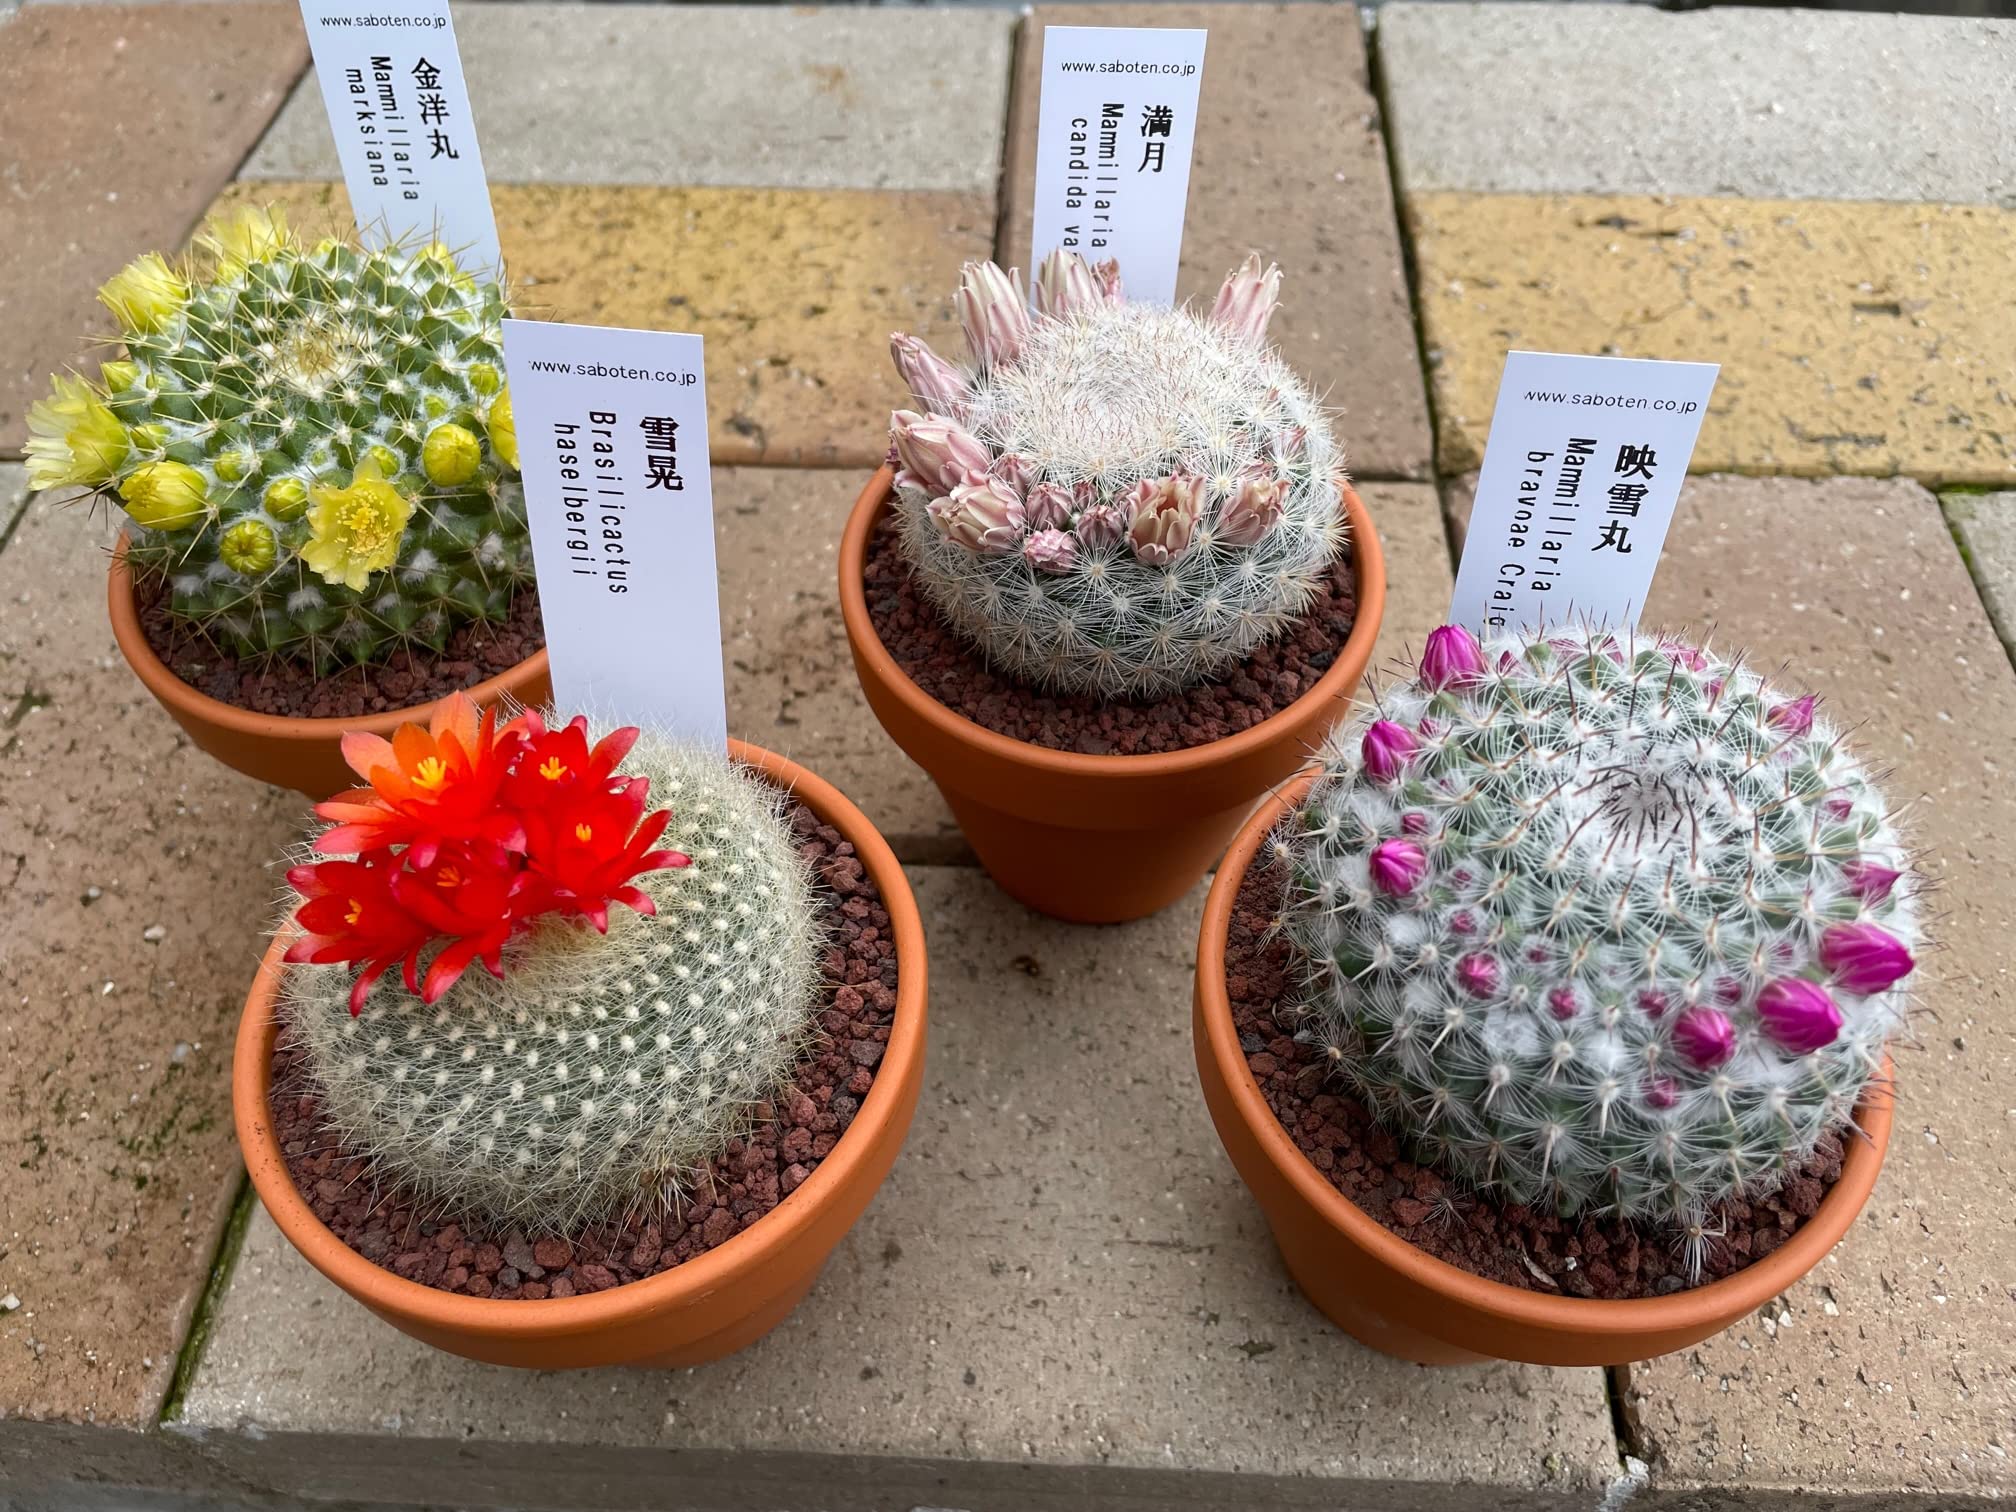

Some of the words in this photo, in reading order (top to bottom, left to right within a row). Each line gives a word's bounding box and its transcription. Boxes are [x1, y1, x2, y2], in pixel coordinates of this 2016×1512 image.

[320, 13, 446, 29] www.saboten.co.jp
[1061, 59, 1196, 77] www.saboten.co.jp
[345, 68, 388, 186] marksiana
[370, 56, 420, 200] Mammillaria
[411, 57, 460, 160] 金洋丸
[1137, 104, 1174, 173] 満月
[1066, 117, 1089, 209] candida
[1091, 103, 1125, 248] Mammillaria
[528, 359, 697, 387] www.saboten.co.jp
[1523, 389, 1698, 415] www.saboten.co.jp
[553, 422, 597, 576] haselbergii
[588, 410, 631, 594] Brasilicactus
[639, 415, 685, 492] 雪晃
[1507, 450, 1555, 549] bravoae
[1591, 443, 1659, 554] 映雪丸
[1530, 437, 1598, 592] Mammillaria
